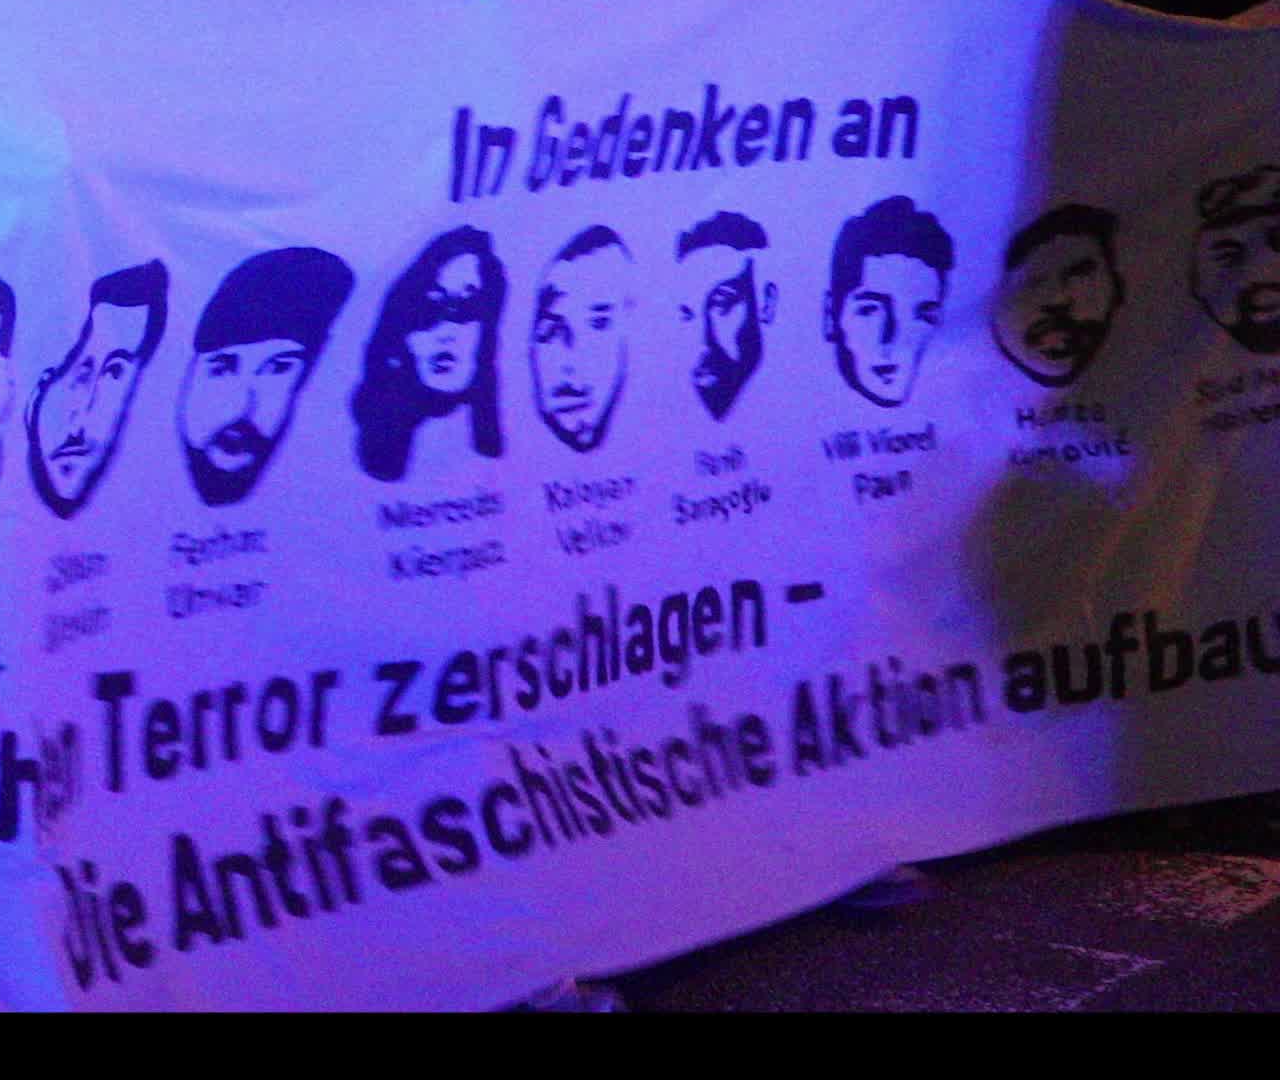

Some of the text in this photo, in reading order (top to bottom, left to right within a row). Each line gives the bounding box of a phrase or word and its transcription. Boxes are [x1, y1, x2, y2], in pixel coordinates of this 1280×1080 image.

[449, 82, 921, 203] In Gedenken an
[92, 669, 338, 793] Terror
[374, 577, 766, 735] zerschlagen
[169, 700, 776, 953] Antifaschistische
[789, 651, 987, 776] Aktion
